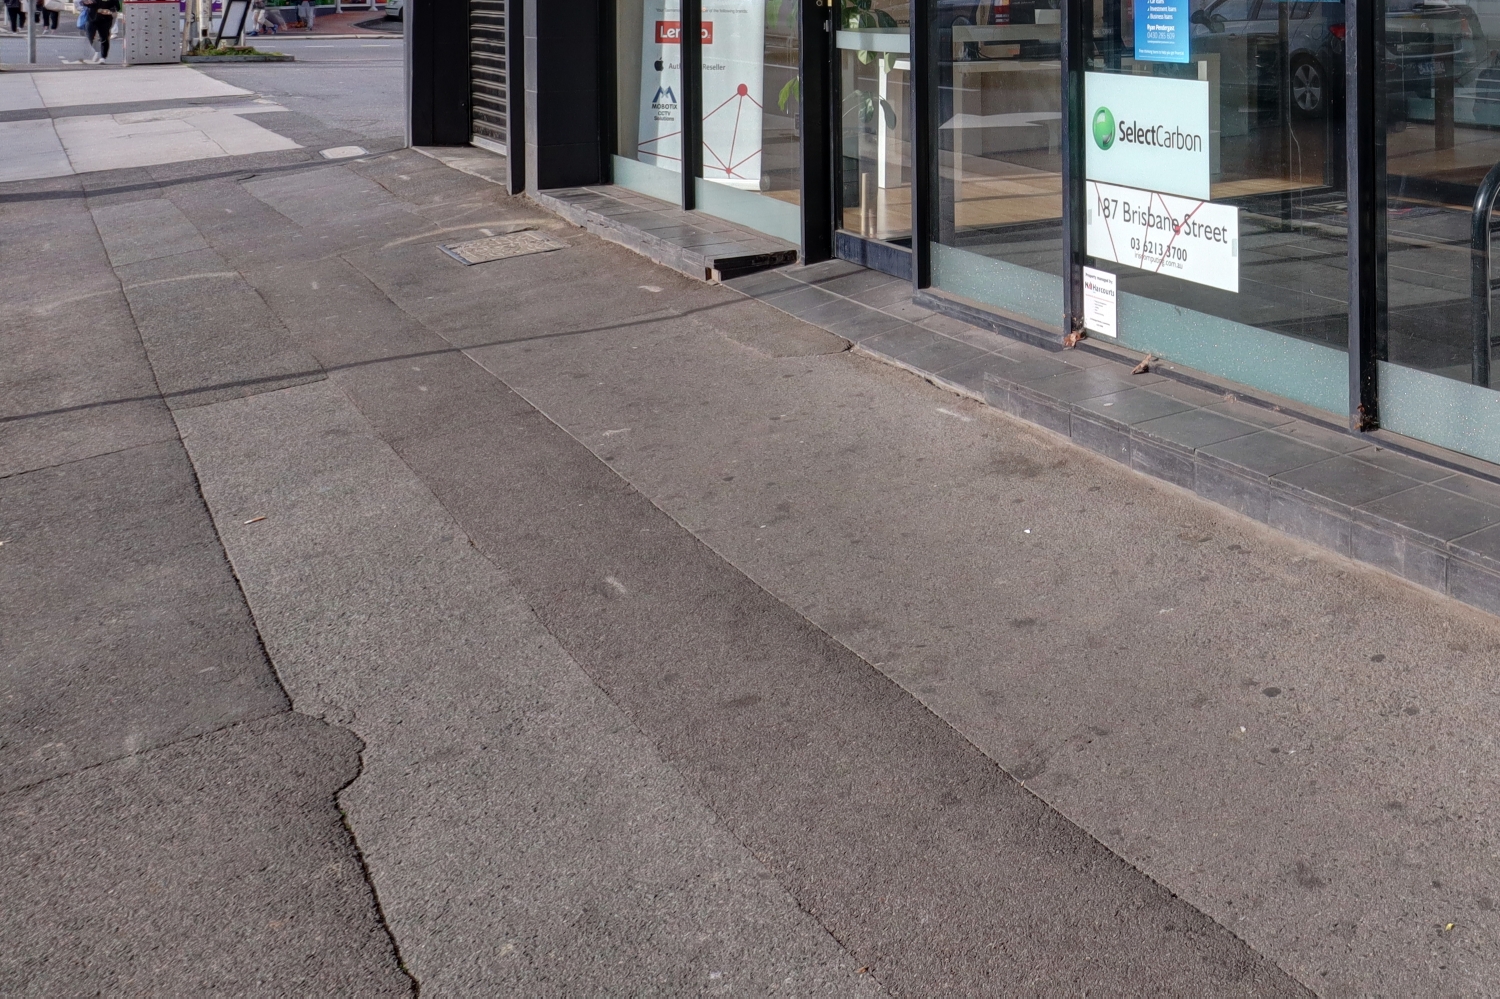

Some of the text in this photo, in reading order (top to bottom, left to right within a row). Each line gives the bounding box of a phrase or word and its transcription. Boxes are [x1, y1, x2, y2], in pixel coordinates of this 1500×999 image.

[1119, 120, 1202, 152] SelectCarbon
[1097, 196, 1228, 244] 187 Brisbane Street
[1130, 237, 1188, 262] 03 6213 3700
